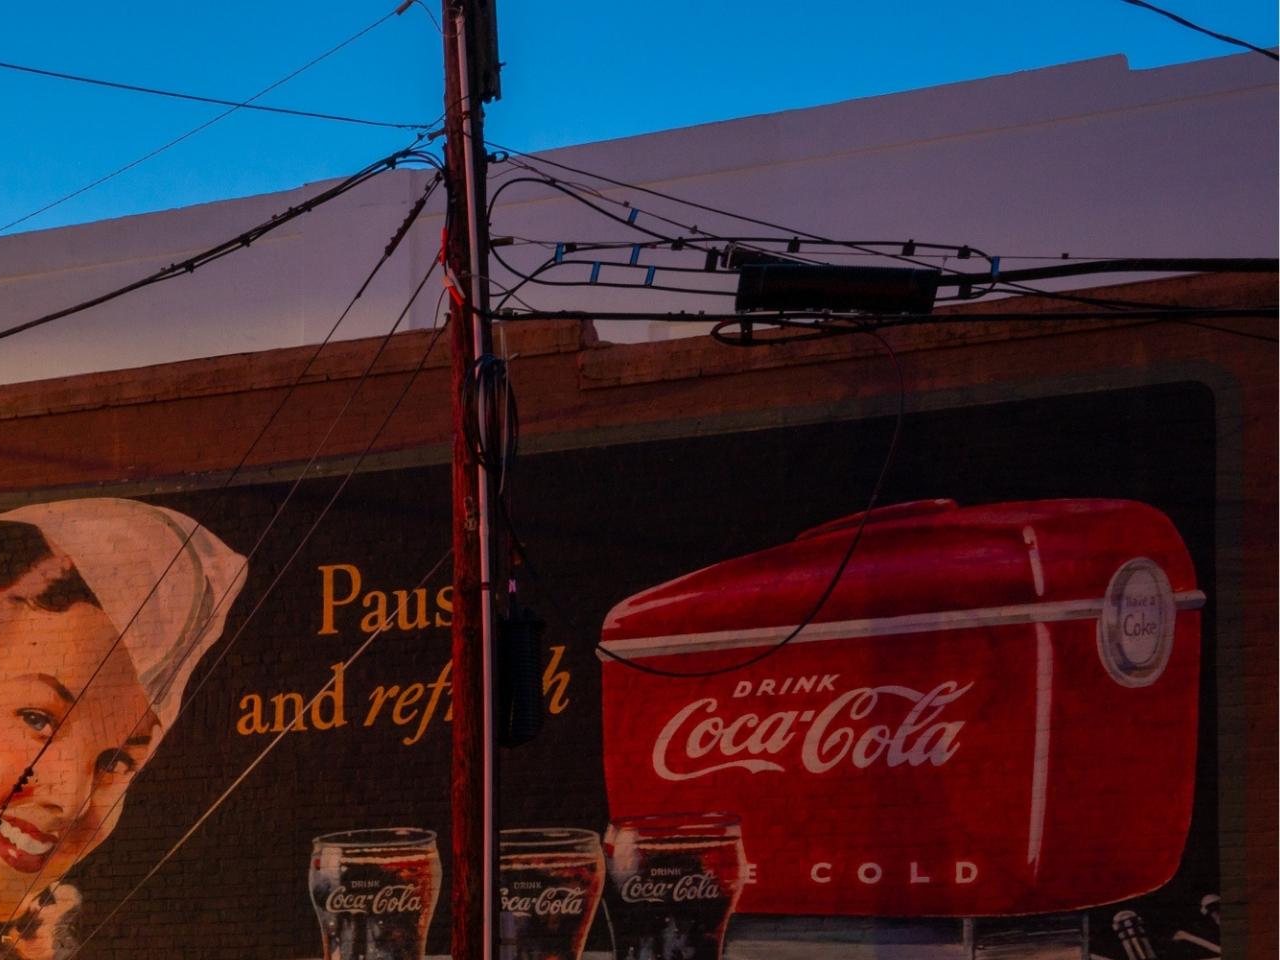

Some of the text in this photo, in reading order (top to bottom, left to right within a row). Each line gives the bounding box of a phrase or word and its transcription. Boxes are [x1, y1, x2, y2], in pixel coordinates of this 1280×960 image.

[317, 562, 453, 636] Paus
[1123, 613, 1157, 636] Coke
[235, 644, 571, 746] and refh
[732, 673, 843, 699] DRINK
[652, 680, 974, 782] Coca-Cola
[351, 880, 380, 889] DRINK
[513, 881, 542, 889] DRINK
[650, 868, 682, 876] DRINK
[809, 861, 983, 886] COLD
[325, 883, 423, 914] Coca-Cola
[620, 870, 721, 903] Coca-Cola
